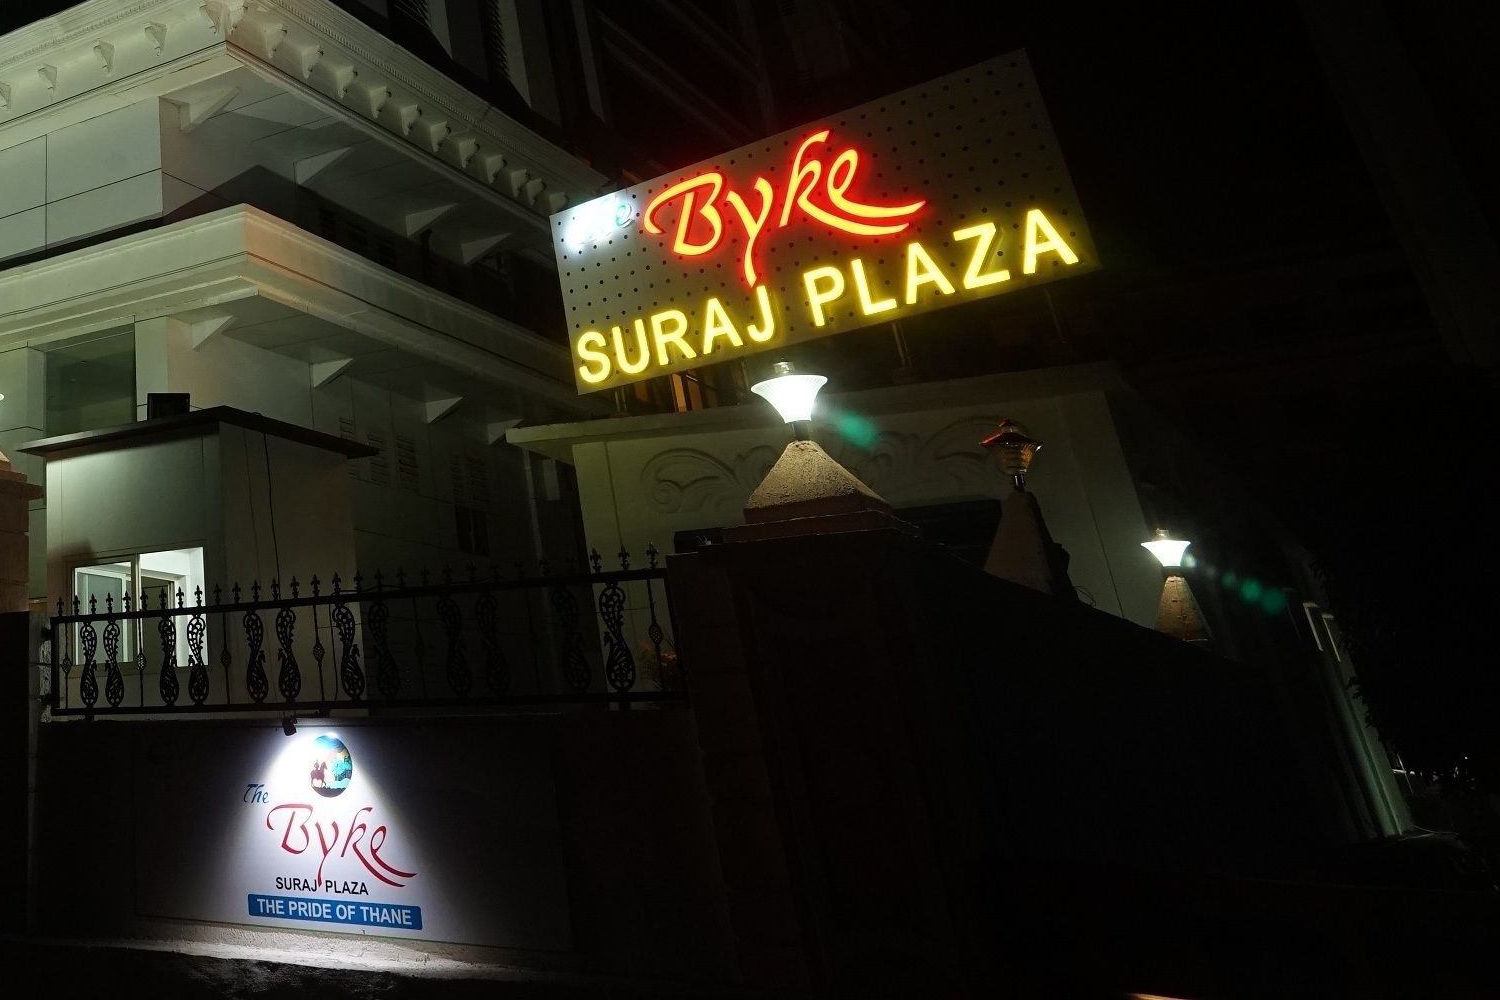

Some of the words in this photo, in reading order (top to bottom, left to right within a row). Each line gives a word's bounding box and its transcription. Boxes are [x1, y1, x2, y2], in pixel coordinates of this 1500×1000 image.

[643, 129, 926, 287] Byke
[576, 285, 777, 384] SURAJ
[803, 208, 1079, 328] PLAZA
[244, 783, 270, 804] The
[266, 803, 418, 888] Byke
[257, 898, 285, 916] THE
[288, 901, 332, 919] PRIDE
[336, 904, 356, 921] OF
[360, 908, 413, 926] THANE
[275, 876, 318, 893] SURAJ
[325, 880, 369, 896] PLAZA
